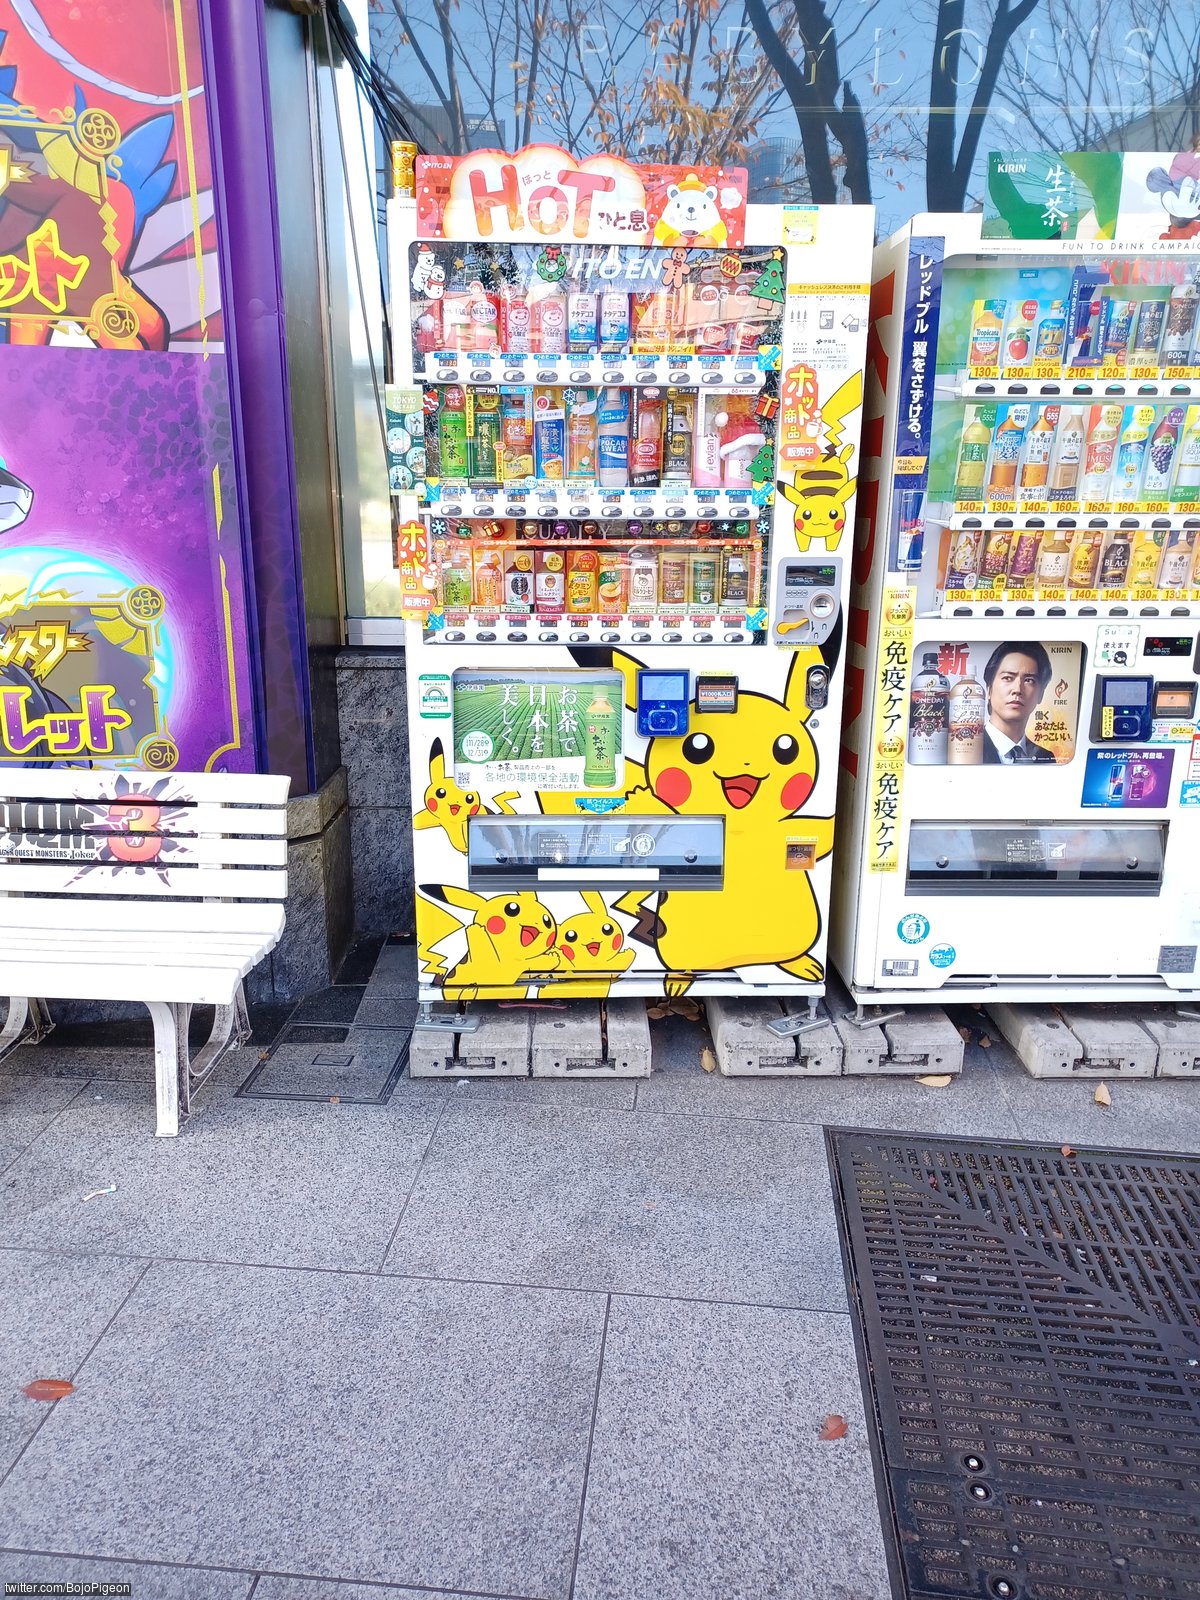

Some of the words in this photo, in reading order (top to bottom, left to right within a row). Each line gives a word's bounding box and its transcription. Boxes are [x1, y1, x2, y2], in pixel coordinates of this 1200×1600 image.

[997, 164, 1027, 174] KIRIN
[521, 170, 552, 187] ほっと
[1041, 164, 1069, 227] 生茶
[1061, 243, 1084, 251] FUN
[1091, 243, 1104, 251] TO
[1110, 243, 1146, 251] DRINK
[624, 258, 663, 281] EN
[1100, 258, 1186, 286] KIRIN
[913, 254, 934, 335] レッドブル
[603, 310, 627, 318] ナタデココ
[976, 328, 999, 337] Tropicana
[975, 367, 997, 377] 130円
[1007, 367, 1030, 377] 130円
[1036, 367, 1059, 377] 130円
[1068, 367, 1092, 378] 210円
[1102, 367, 1125, 378] 120円
[1134, 367, 1157, 378] 130円
[1167, 367, 1191, 378] 150円
[907, 341, 929, 440] 翼をさずける。
[786, 366, 814, 427] ホット
[784, 409, 800, 440] 商品
[707, 436, 715, 466] evian
[786, 446, 815, 458] 販売中
[960, 502, 982, 512] 140円
[992, 502, 1014, 512] 130円
[1024, 502, 1046, 512] 140円
[1055, 502, 1077, 512] 160円
[1088, 502, 1110, 512] 160円
[1118, 502, 1140, 512] 160円
[1146, 502, 1168, 512] 160円
[401, 522, 427, 579] ホット
[401, 560, 417, 590] 商品
[950, 590, 972, 600] 130円
[979, 590, 1001, 600] 130円
[1011, 590, 1033, 600] 130円
[1042, 590, 1065, 600] 140円
[1075, 590, 1097, 600] 140円
[1105, 590, 1127, 600] 140円
[1136, 590, 1158, 600] 130円
[1165, 590, 1187, 600] 130円
[884, 629, 912, 638] おいしい
[937, 642, 971, 677] 新
[881, 640, 909, 733] 免疫ケア
[913, 703, 945, 718] Black
[1034, 710, 1050, 721] 働く
[0, 685, 132, 754] レット
[500, 685, 519, 753] 美しく。
[527, 685, 550, 753] 日本を
[556, 685, 579, 752] お茶で
[1034, 721, 1069, 731] あなたは、
[1034, 732, 1074, 742] かっこいい。
[876, 761, 903, 770] おいしい
[485, 772, 580, 783] 各地の環境保全活動
[873, 772, 900, 860] 免疫ケア
[107, 793, 164, 863] 3
[14, 849, 34, 857] QUEST
[35, 850, 69, 858] MONSTERS
[69, 850, 96, 859] Joker
